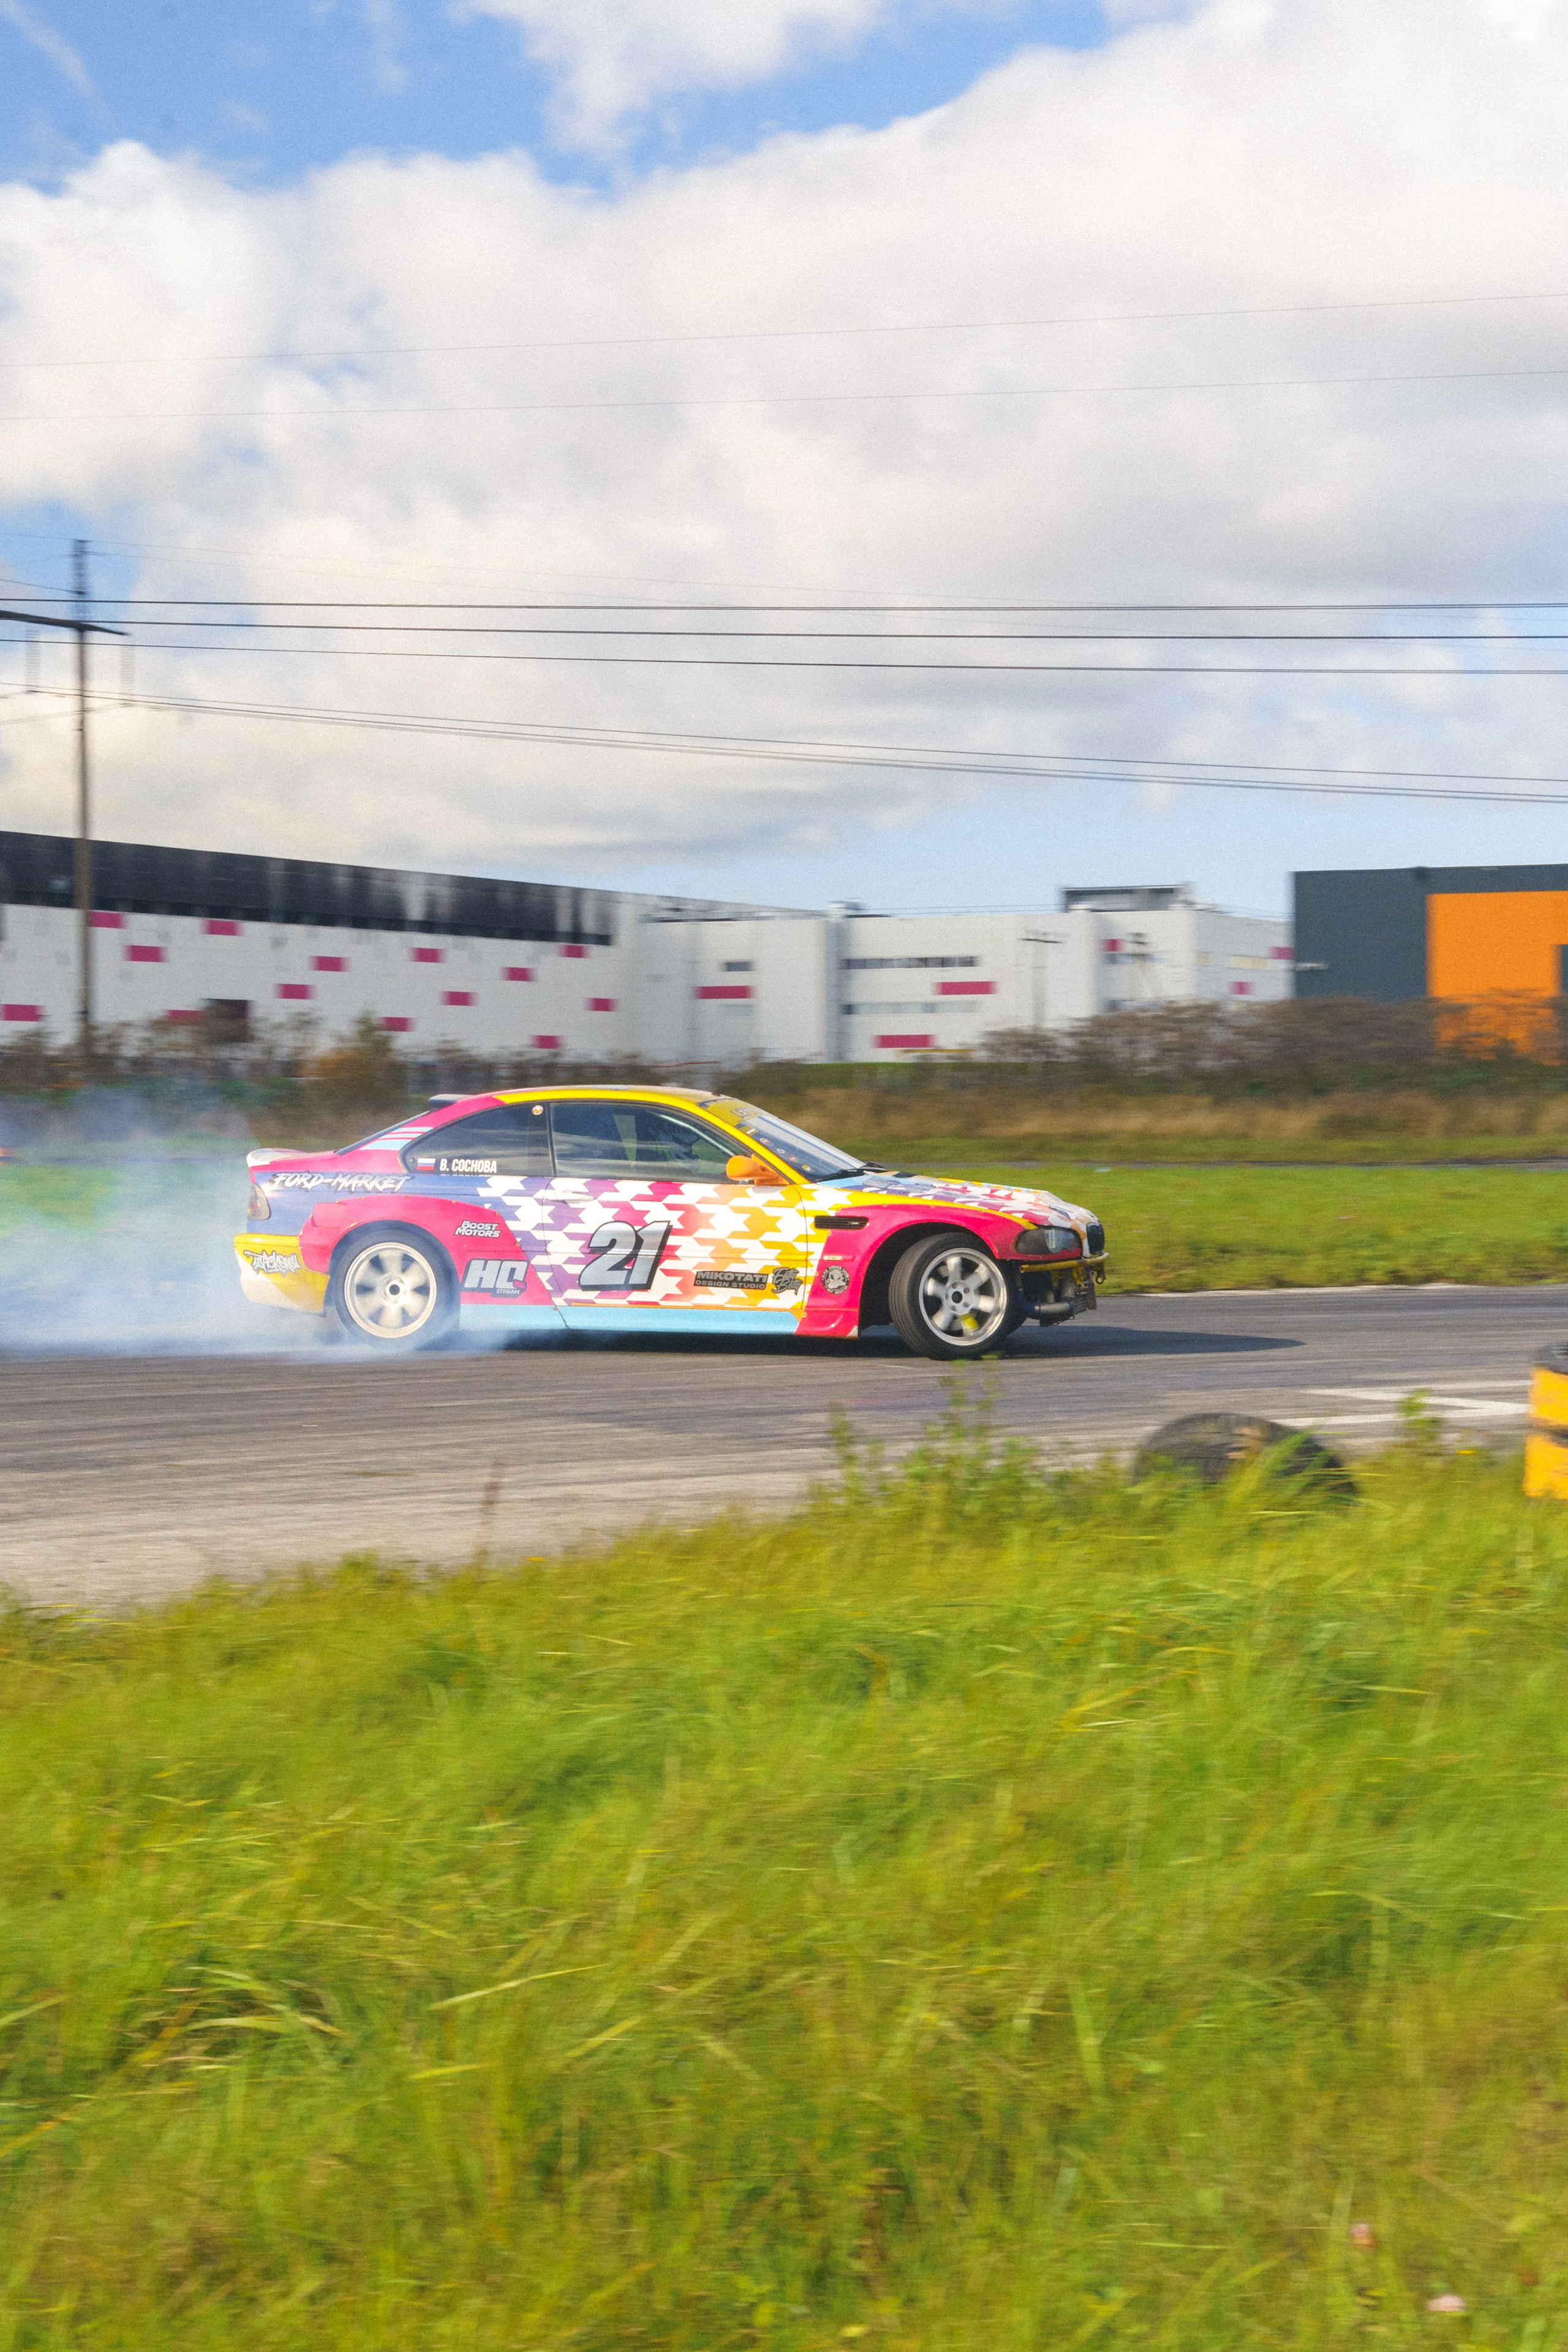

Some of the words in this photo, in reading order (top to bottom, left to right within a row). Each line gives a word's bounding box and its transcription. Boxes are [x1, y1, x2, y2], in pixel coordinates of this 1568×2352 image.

[270, 1172, 414, 1193] FORD-MARKET
[461, 1220, 499, 1231] BOOST
[454, 1227, 501, 1238] MOTORS
[579, 1221, 673, 1291] 21
[696, 1272, 766, 1283] MIKOTATI
